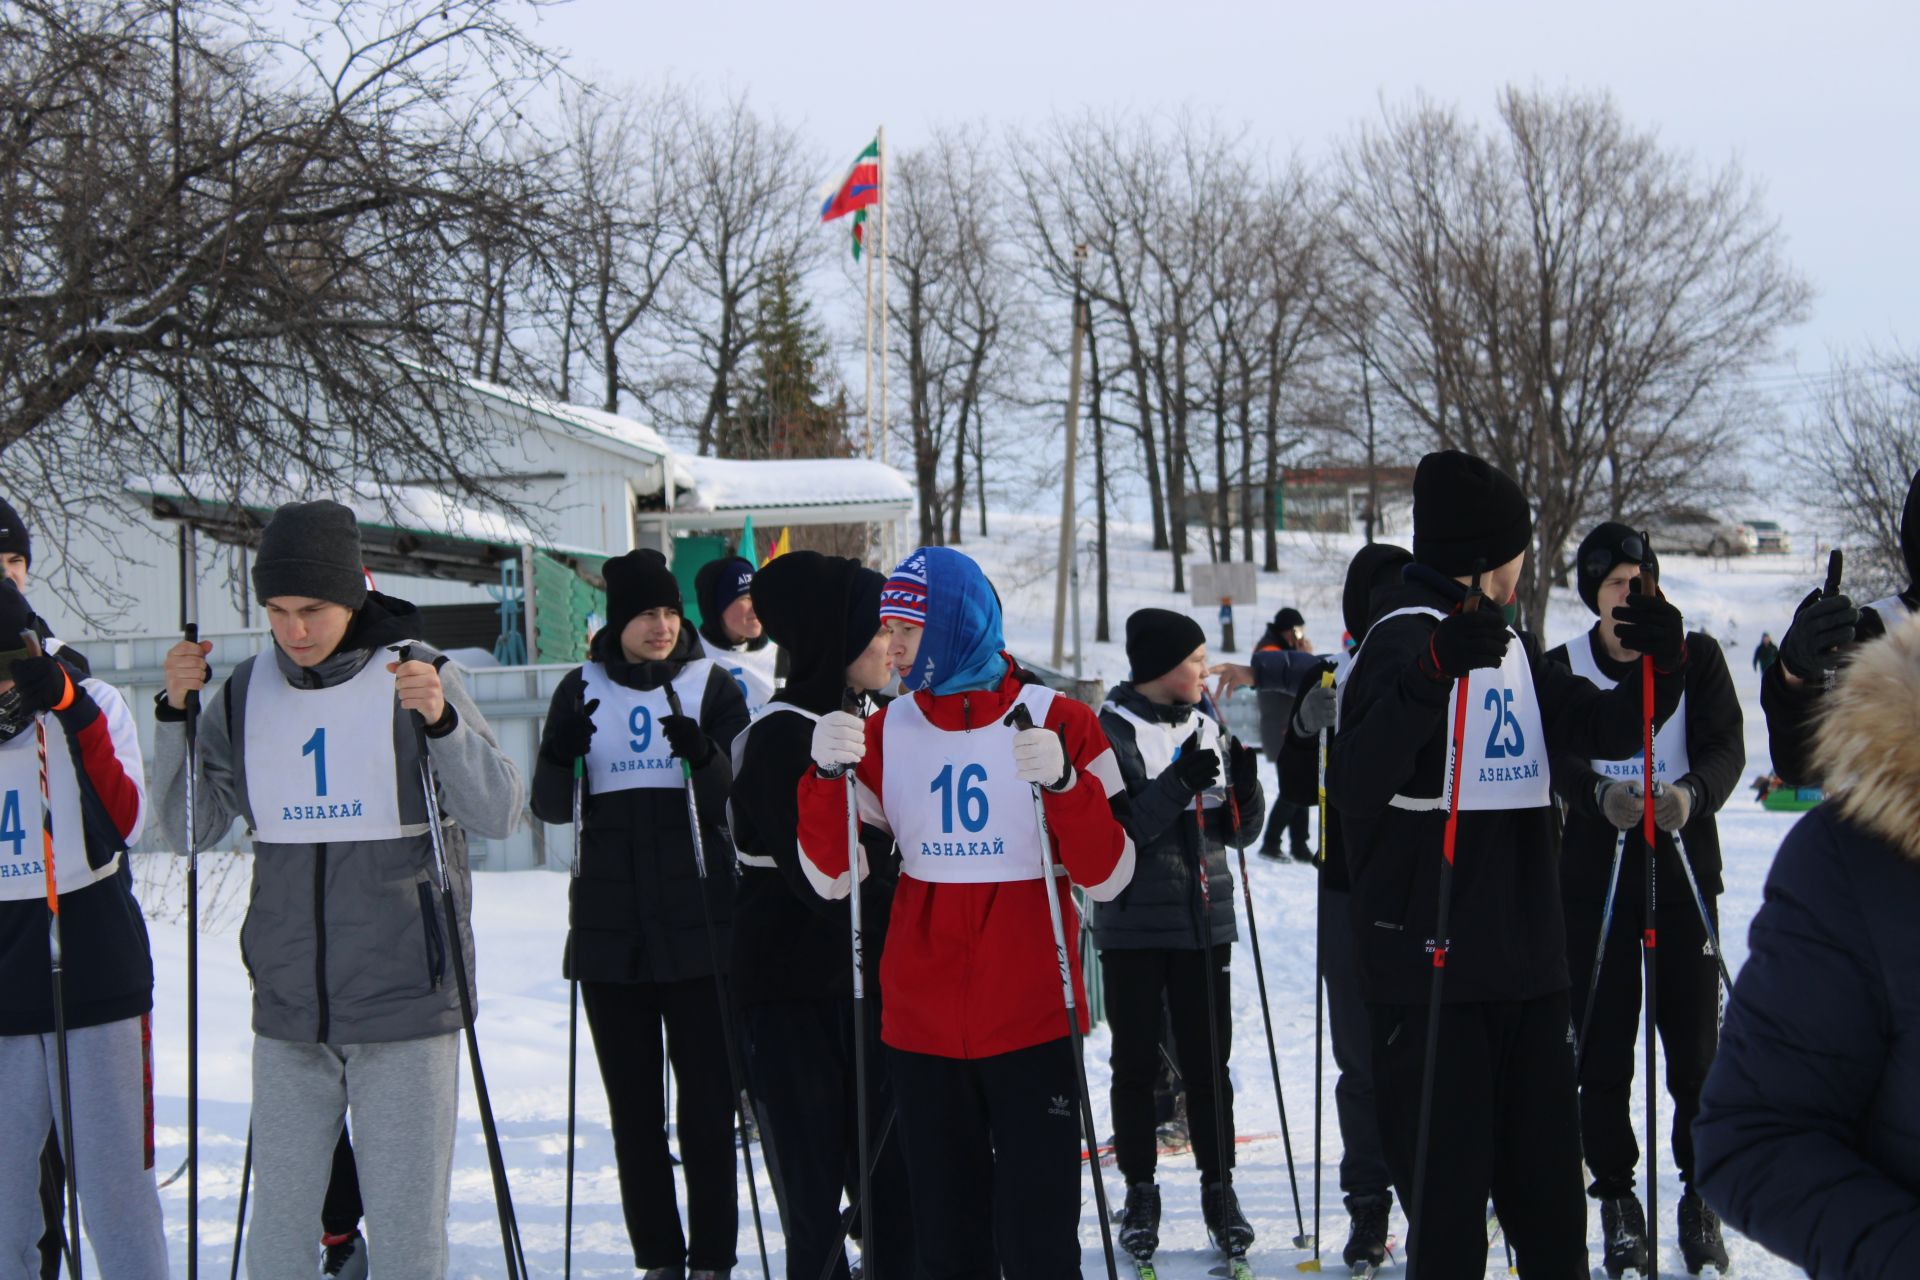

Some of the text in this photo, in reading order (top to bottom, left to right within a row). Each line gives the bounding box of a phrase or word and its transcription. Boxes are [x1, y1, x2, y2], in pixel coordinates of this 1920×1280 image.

[629, 705, 652, 753] 9
[1484, 688, 1525, 758] 25
[302, 727, 327, 796] 1
[611, 756, 674, 773] АЗНАКАЙ
[1479, 760, 1539, 782] АЗНАКАЙ
[1605, 760, 1666, 775] АЗНАЙ
[282, 799, 362, 820] АЗНАКАЙ
[930, 763, 989, 834] 16
[0, 789, 26, 856] 4
[921, 837, 1005, 856] АЗНАКАЙ
[0, 859, 46, 878] НАКА
